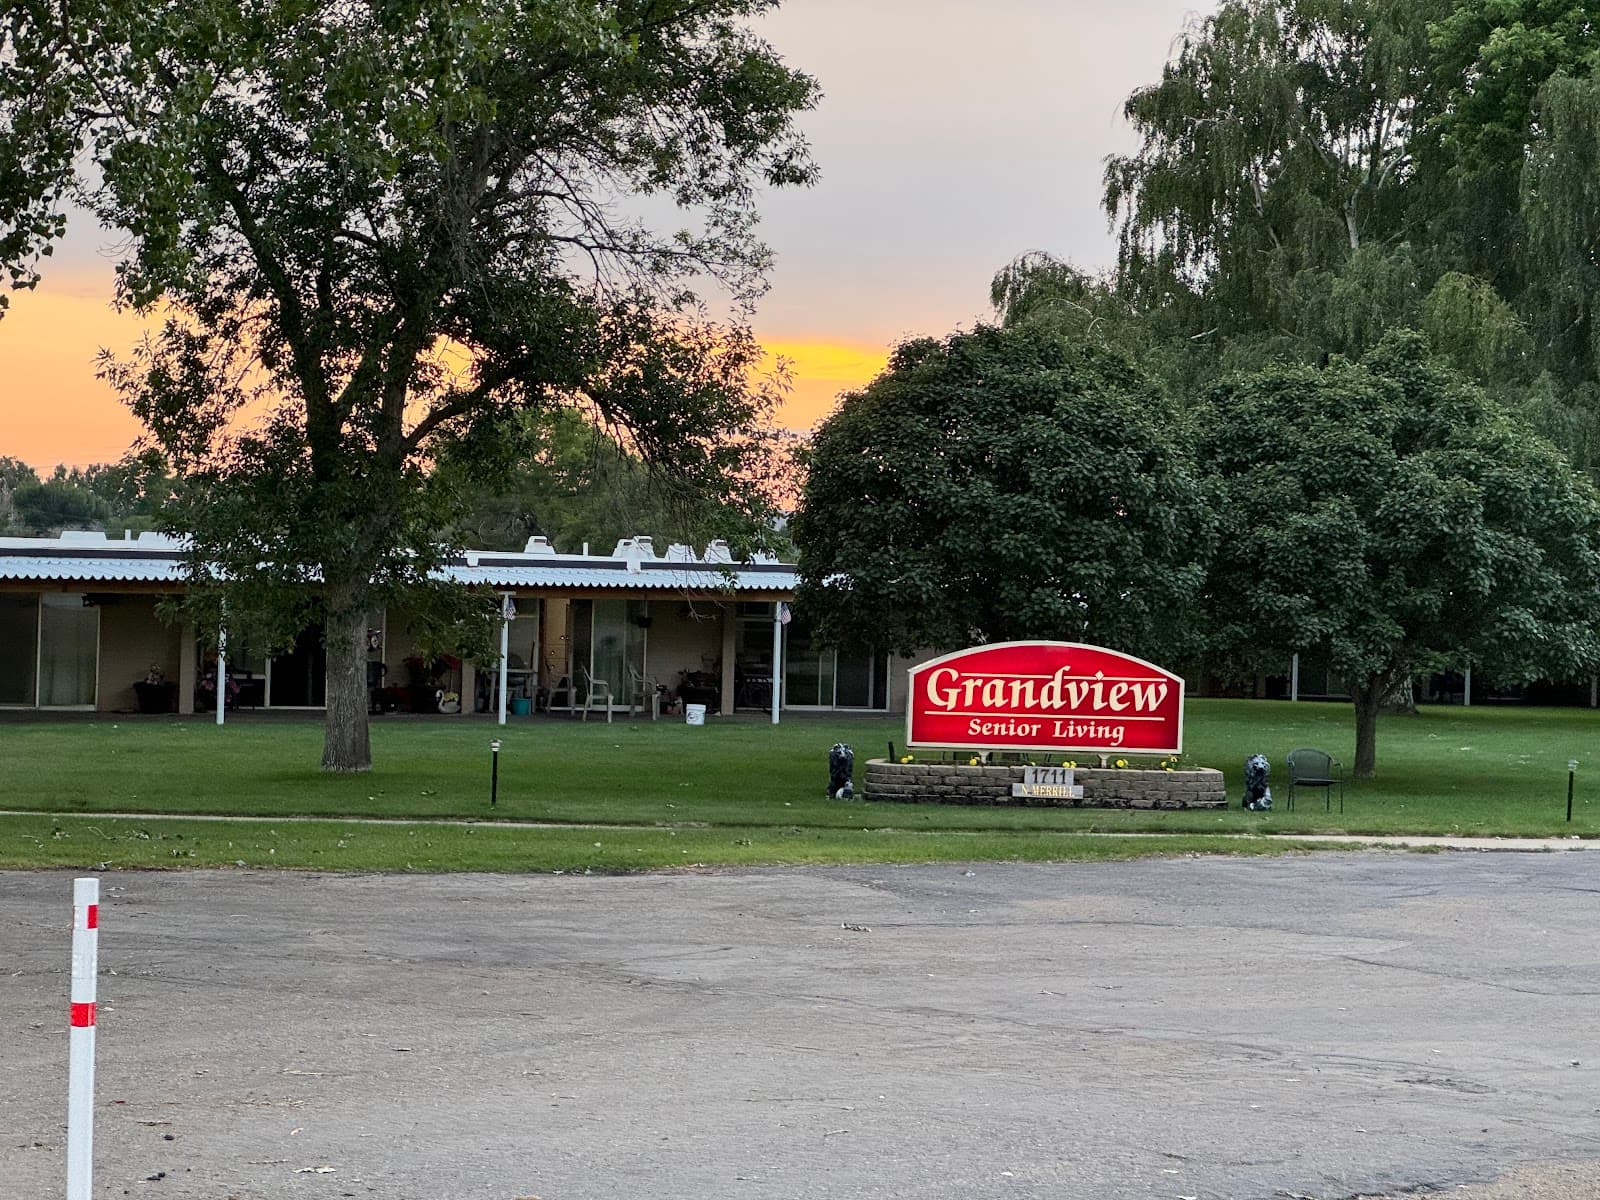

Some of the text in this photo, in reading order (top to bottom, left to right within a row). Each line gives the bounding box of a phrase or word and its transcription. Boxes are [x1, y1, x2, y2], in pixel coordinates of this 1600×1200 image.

[927, 665, 1168, 712] Grandview
[968, 718, 1125, 746] Senior Living
[1032, 769, 1066, 784] 1711
[1032, 784, 1073, 797] MERRILL
